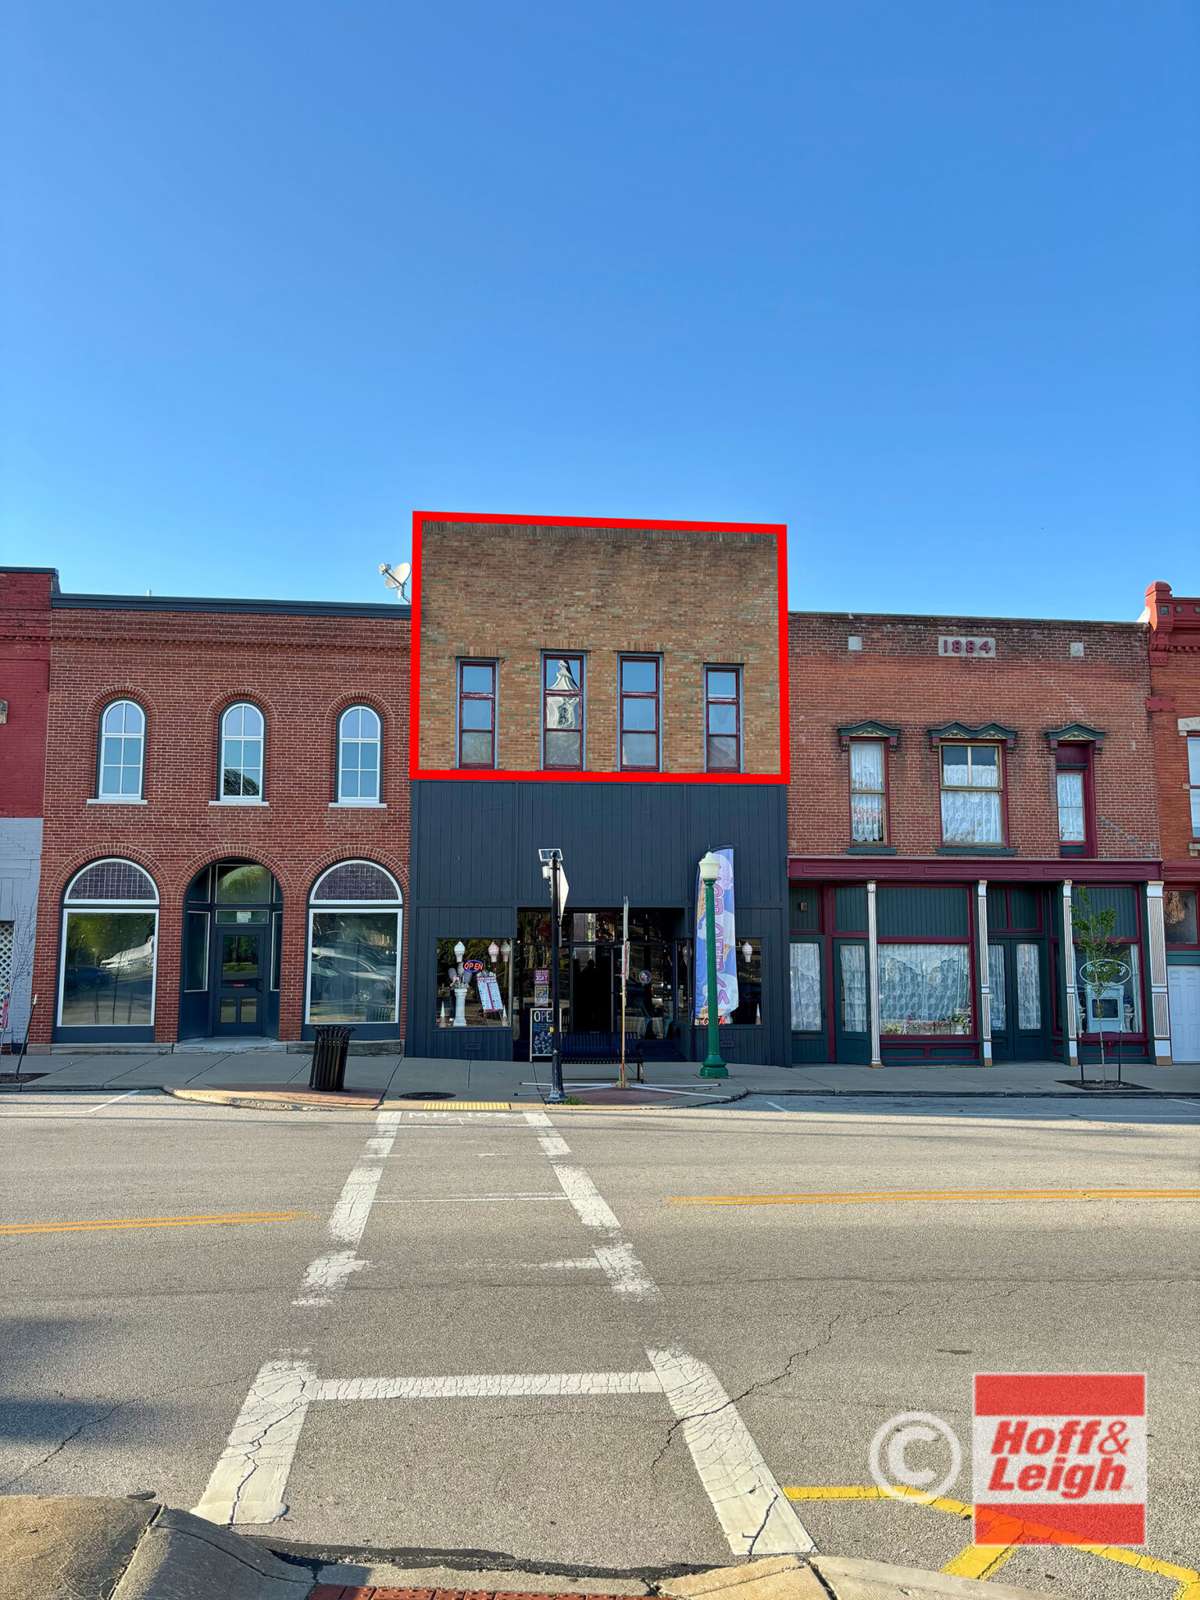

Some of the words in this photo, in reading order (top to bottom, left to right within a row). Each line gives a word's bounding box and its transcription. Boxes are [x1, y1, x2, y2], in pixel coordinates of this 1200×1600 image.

[943, 639, 991, 654] 1884
[464, 962, 484, 970] OPEN
[534, 1010, 553, 1023] OPE
